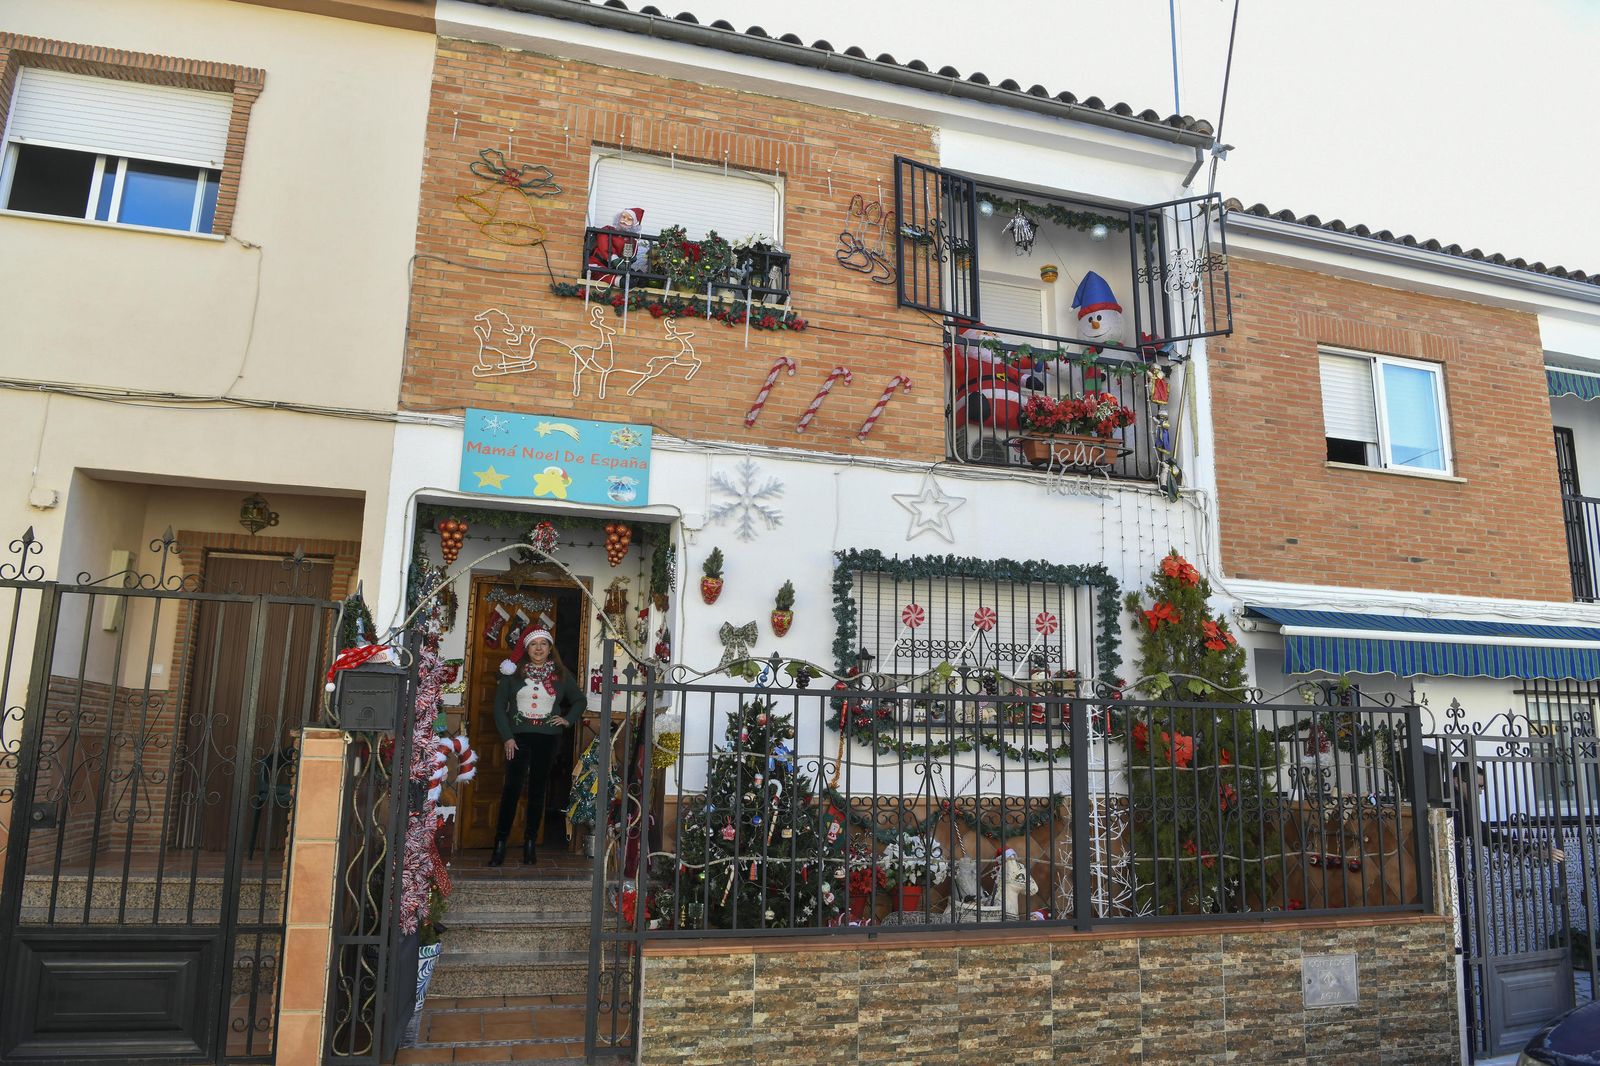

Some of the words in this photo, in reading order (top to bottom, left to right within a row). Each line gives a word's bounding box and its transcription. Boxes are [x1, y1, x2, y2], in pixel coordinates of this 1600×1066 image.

[466, 440, 517, 458] Mamá
[521, 447, 559, 462] Noel
[564, 451, 585, 464] De
[590, 453, 648, 470] España
[268, 511, 280, 527] 8
[1420, 692, 1429, 706] 4
